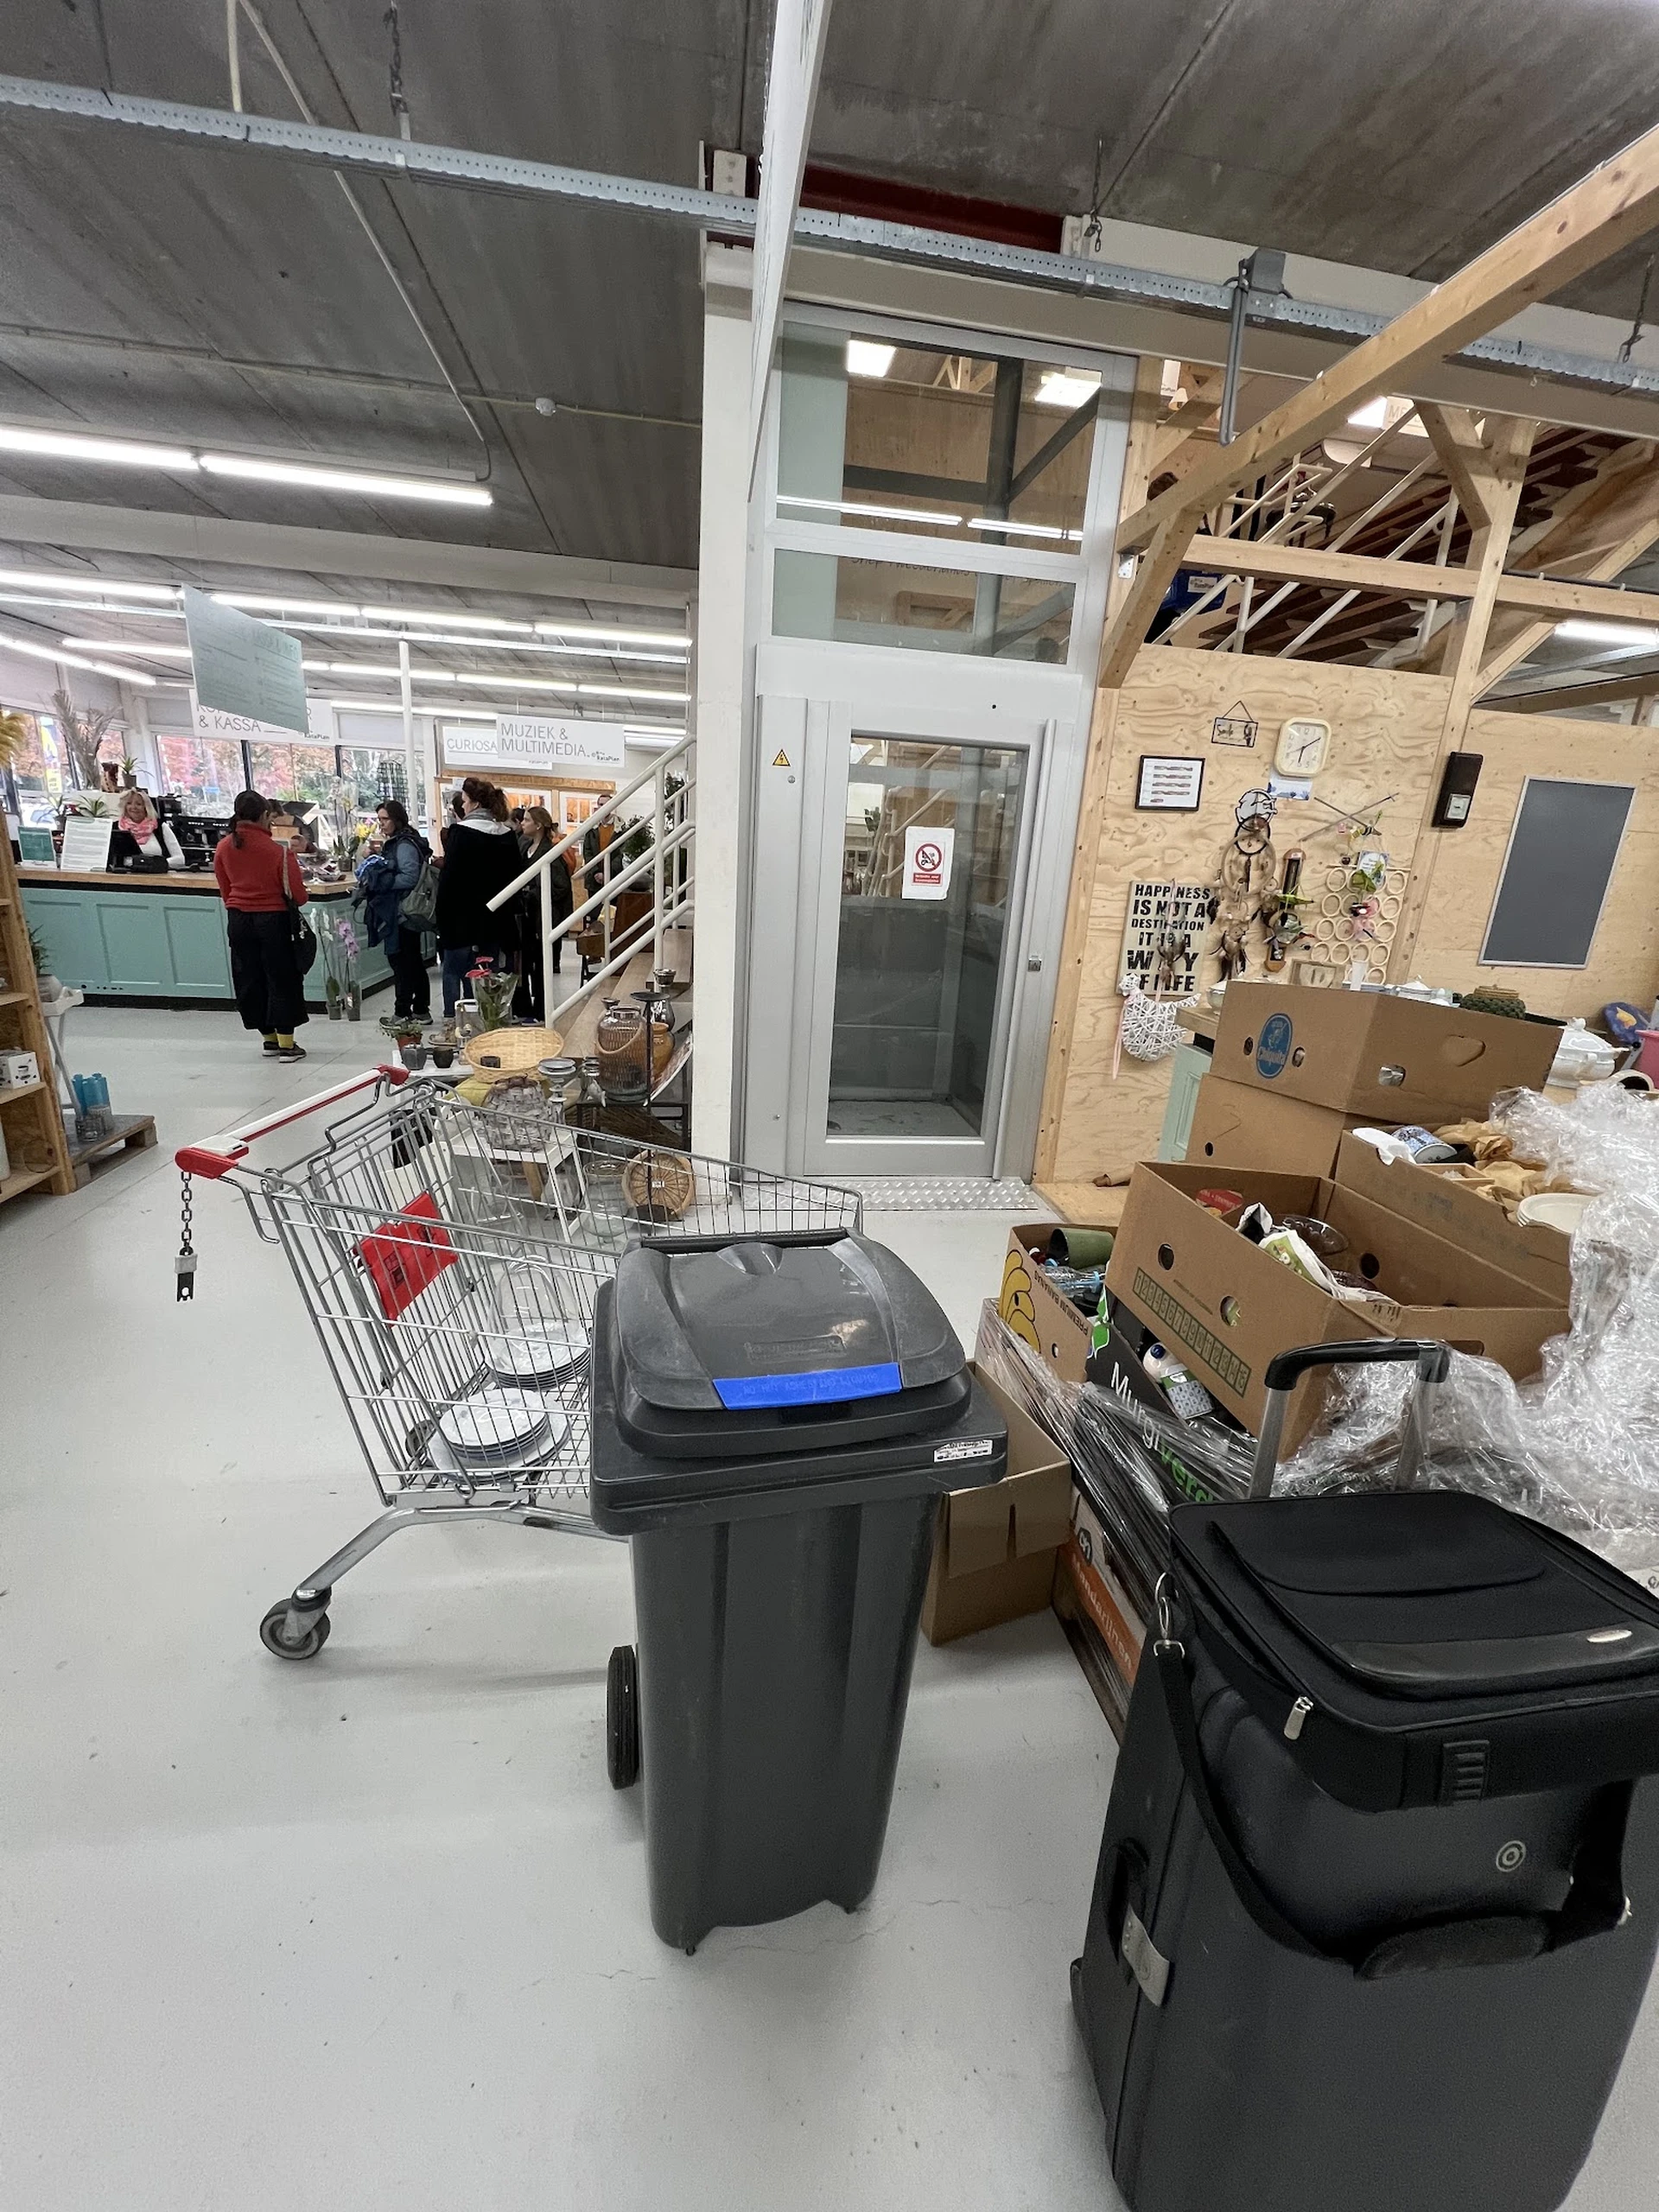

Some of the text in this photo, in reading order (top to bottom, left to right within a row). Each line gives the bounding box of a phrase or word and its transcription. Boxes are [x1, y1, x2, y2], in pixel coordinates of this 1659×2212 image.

[199, 715, 261, 732] & KASSA
[500, 722, 569, 740] MUZIEK &
[447, 738, 498, 752] CURIOSA
[1135, 884, 1211, 899] HAPPNESS
[1133, 899, 1152, 915] IS
[1193, 902, 1206, 918] A
[1138, 931, 1154, 946] IT
[1127, 950, 1199, 972] WY
[1059, 1300, 1089, 1336] PREMIUM
